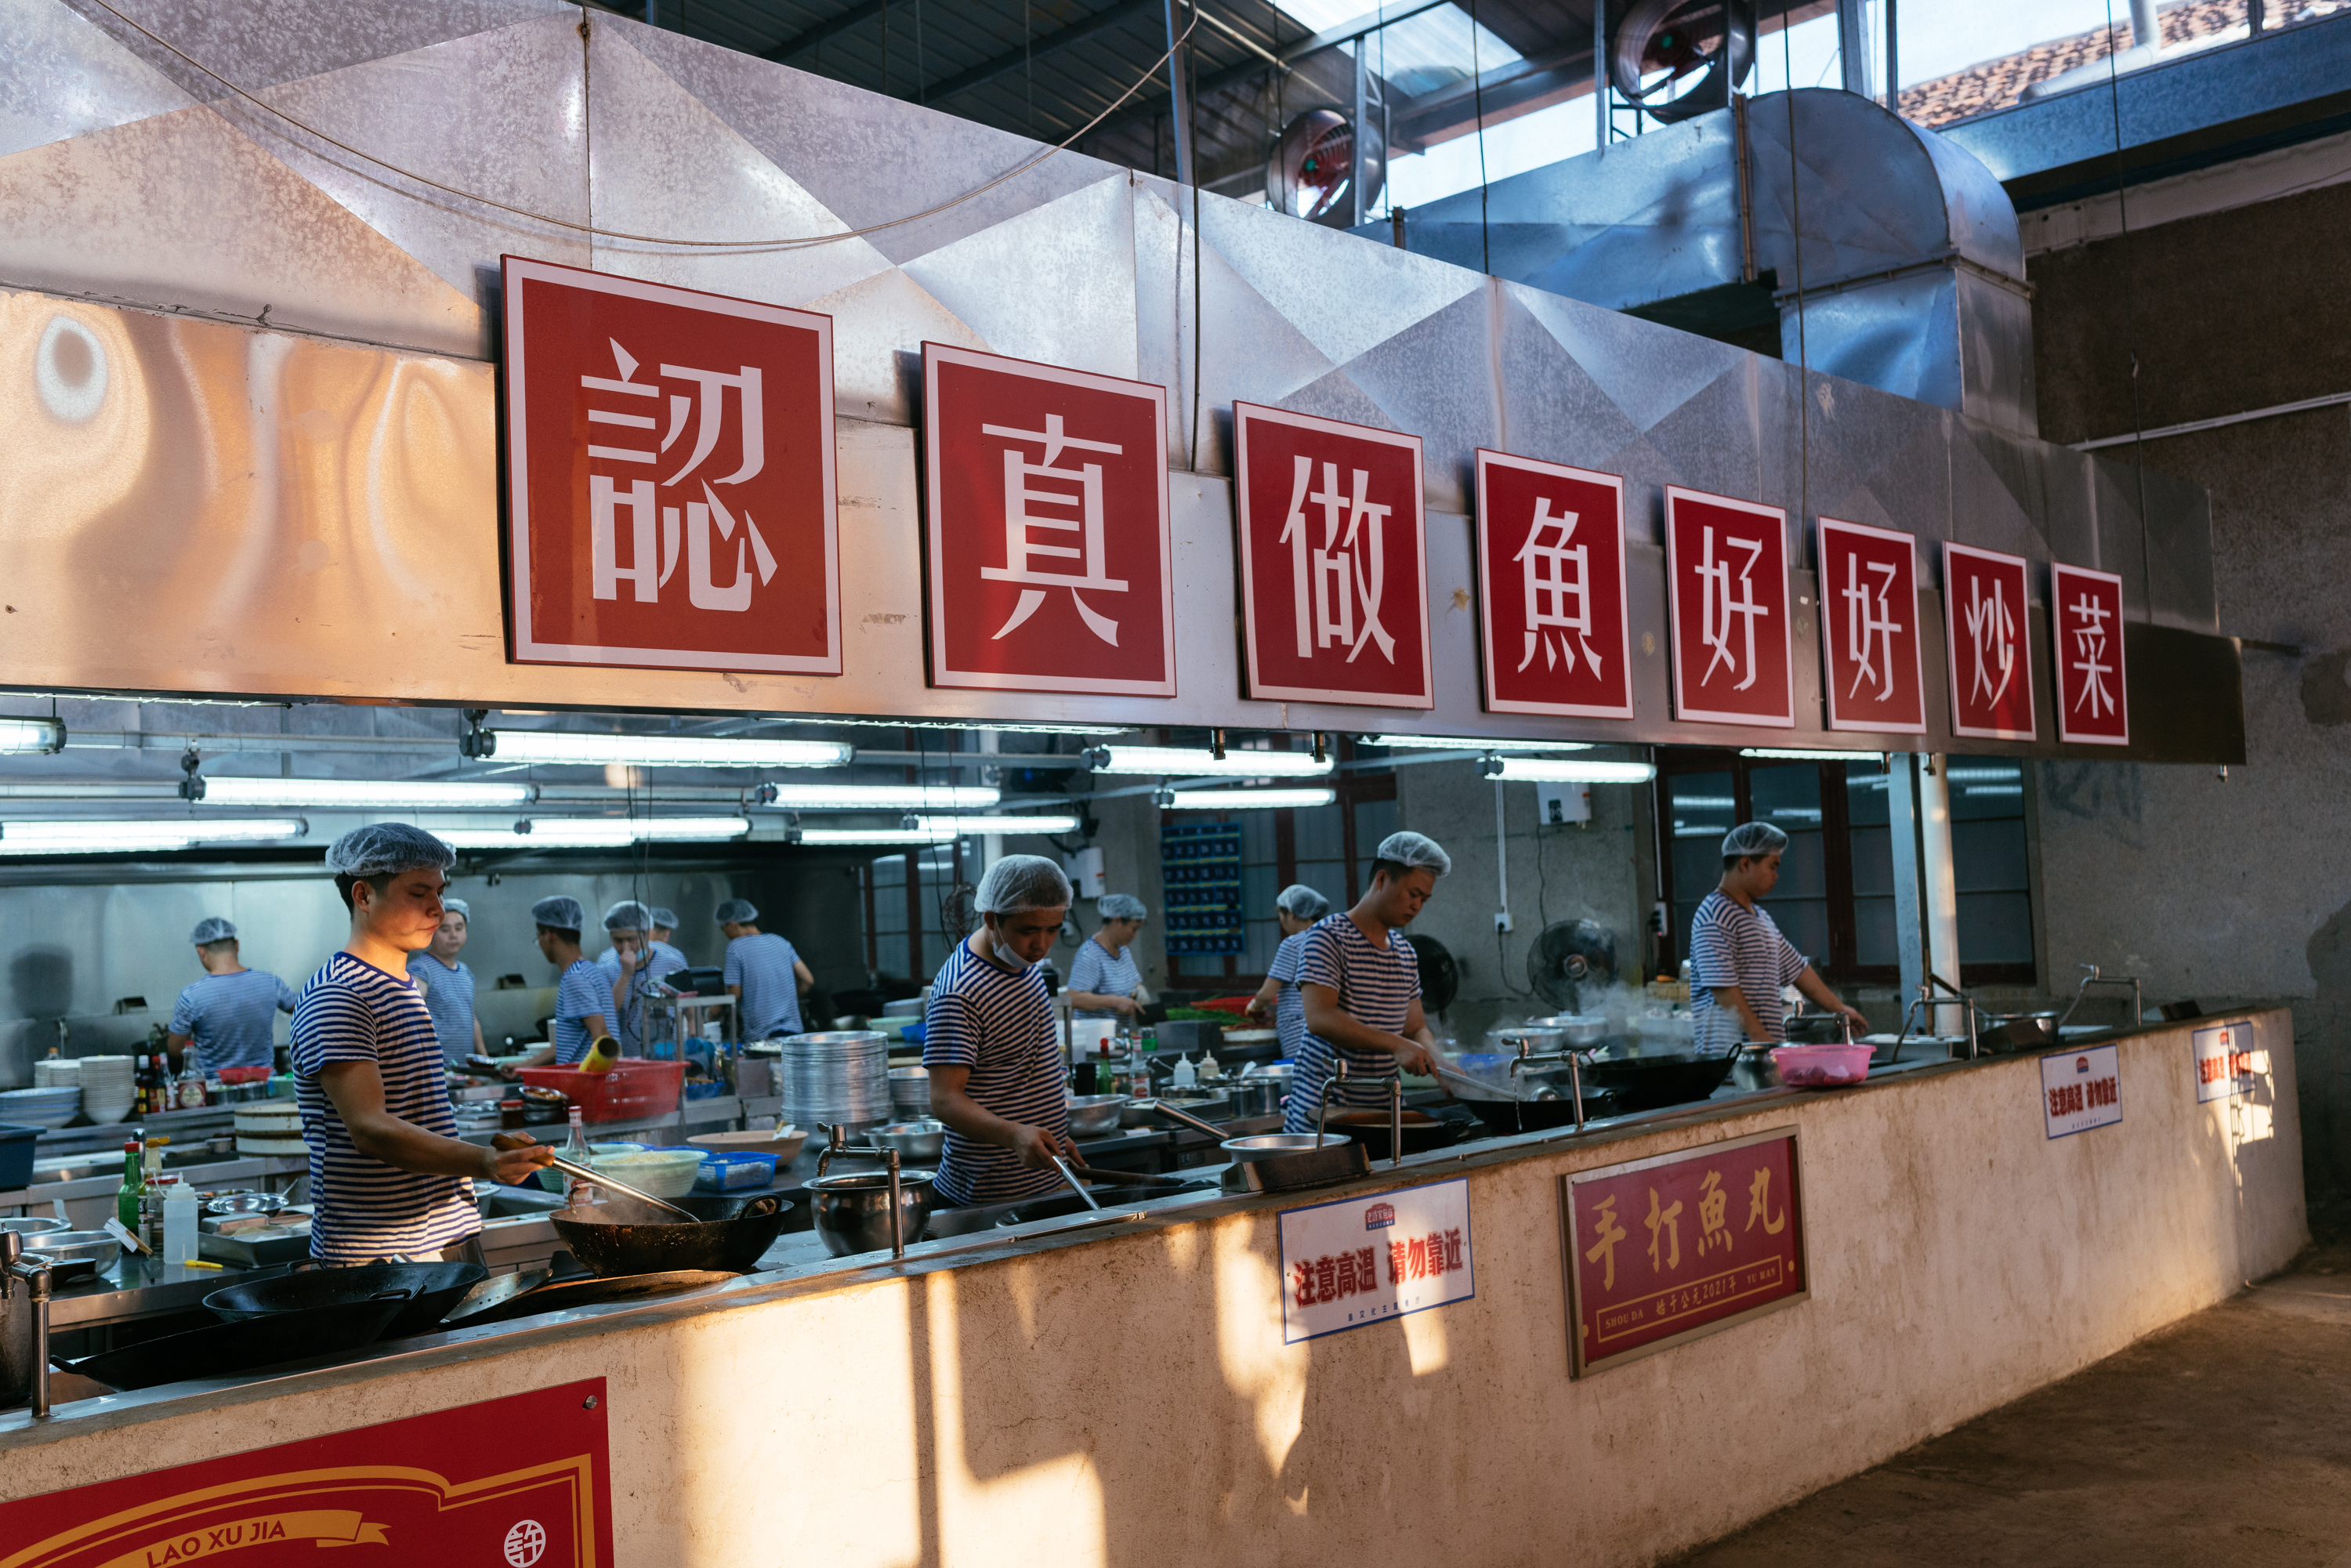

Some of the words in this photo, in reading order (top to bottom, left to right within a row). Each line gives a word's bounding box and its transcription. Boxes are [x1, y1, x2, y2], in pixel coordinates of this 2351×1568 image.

[1585, 1166, 1784, 1291] 手打魚丸
[1294, 1246, 1378, 1308] 注意高温
[1387, 1227, 1463, 1285] 请勿靠近
[1747, 1273, 1757, 1284] YU
[1759, 1267, 1777, 1280] WAN
[1605, 1313, 1629, 1329] SHOU
[1632, 1309, 1644, 1321] DA
[147, 1537, 201, 1568] LAO
[208, 1526, 242, 1551] XU
[249, 1520, 286, 1541] JIA
